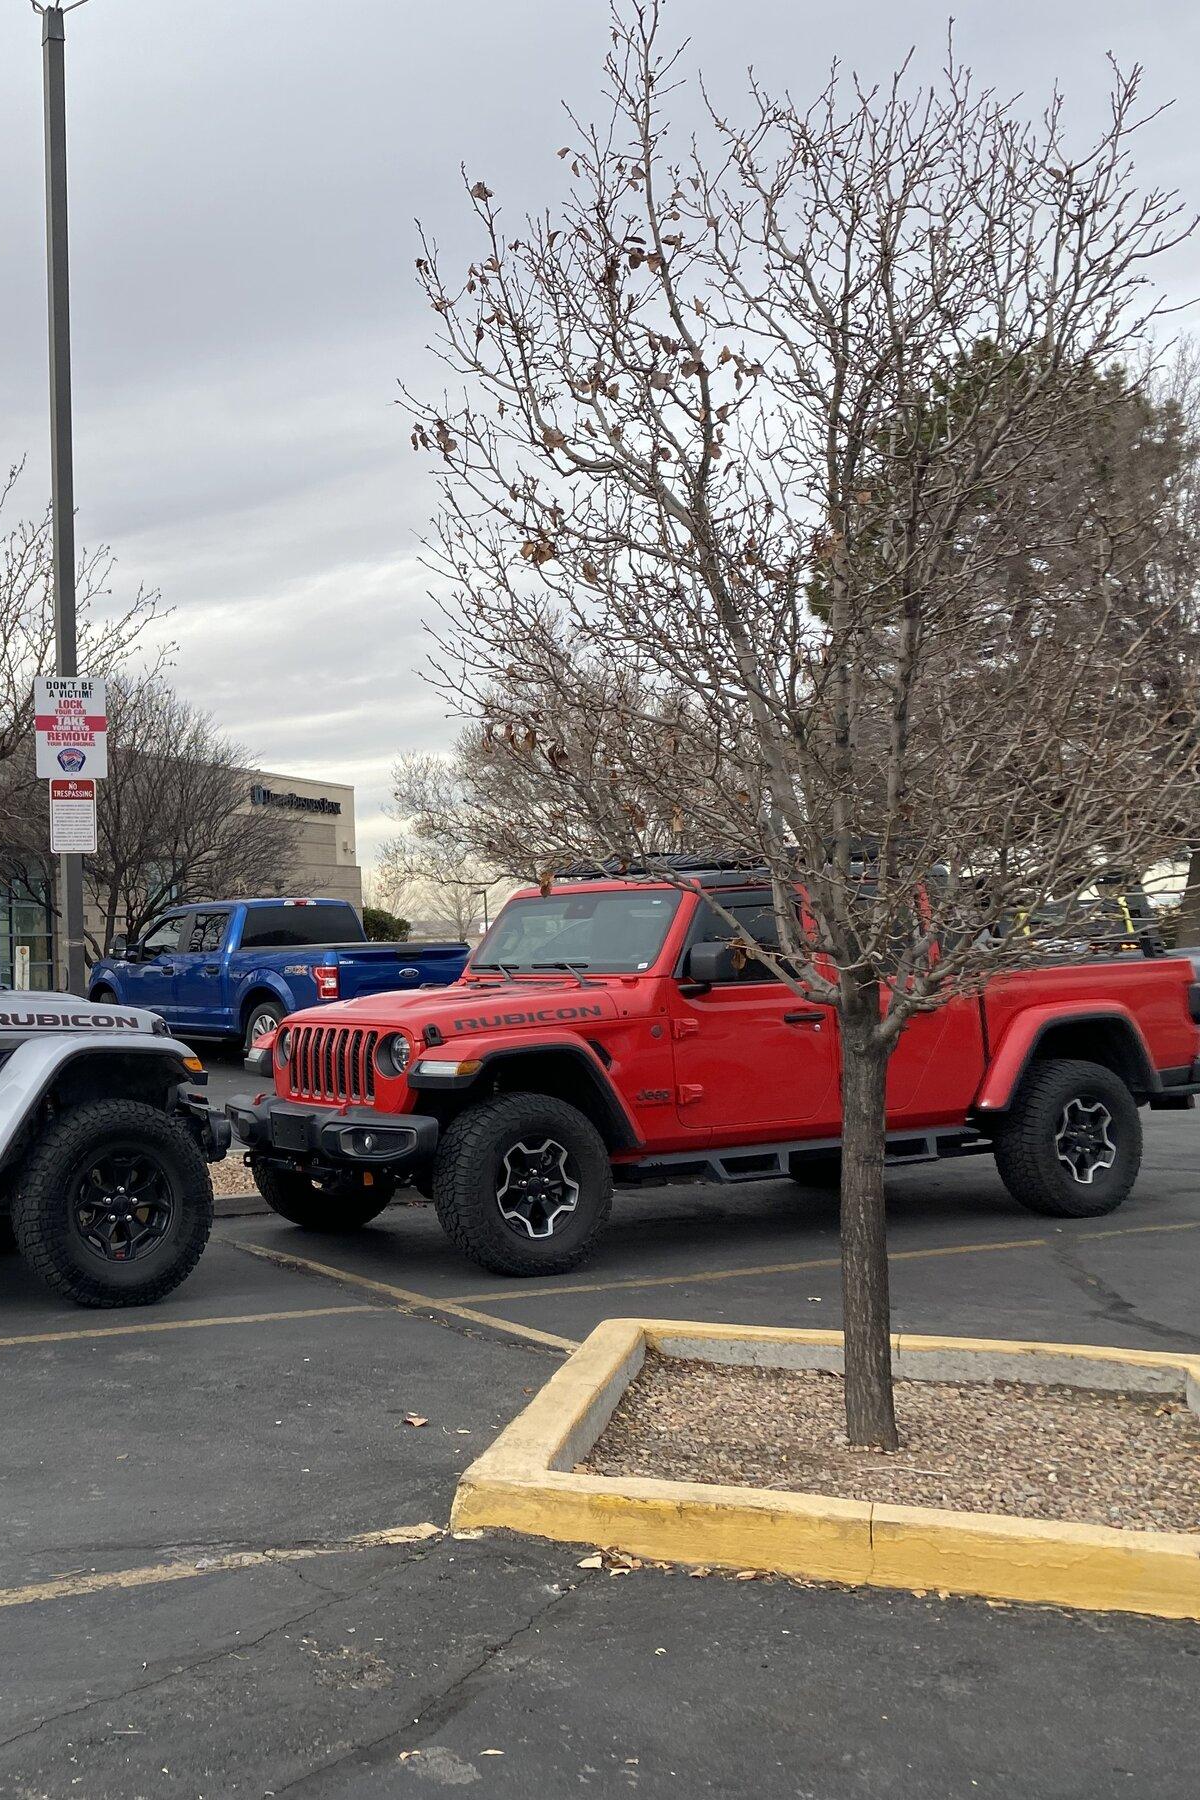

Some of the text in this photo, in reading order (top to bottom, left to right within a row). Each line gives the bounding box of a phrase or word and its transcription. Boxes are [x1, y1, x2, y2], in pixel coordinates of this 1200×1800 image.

[46, 681, 94, 690] DON'T BE
[49, 690, 92, 699] A VICTIM!
[58, 700, 83, 709] LOCK
[56, 716, 86, 726] TAKE
[47, 732, 95, 741] REMOVE
[53, 790, 93, 798] TRESPASSING
[454, 1005, 601, 1031] RUBICON
[636, 1087, 670, 1101] Jeep
